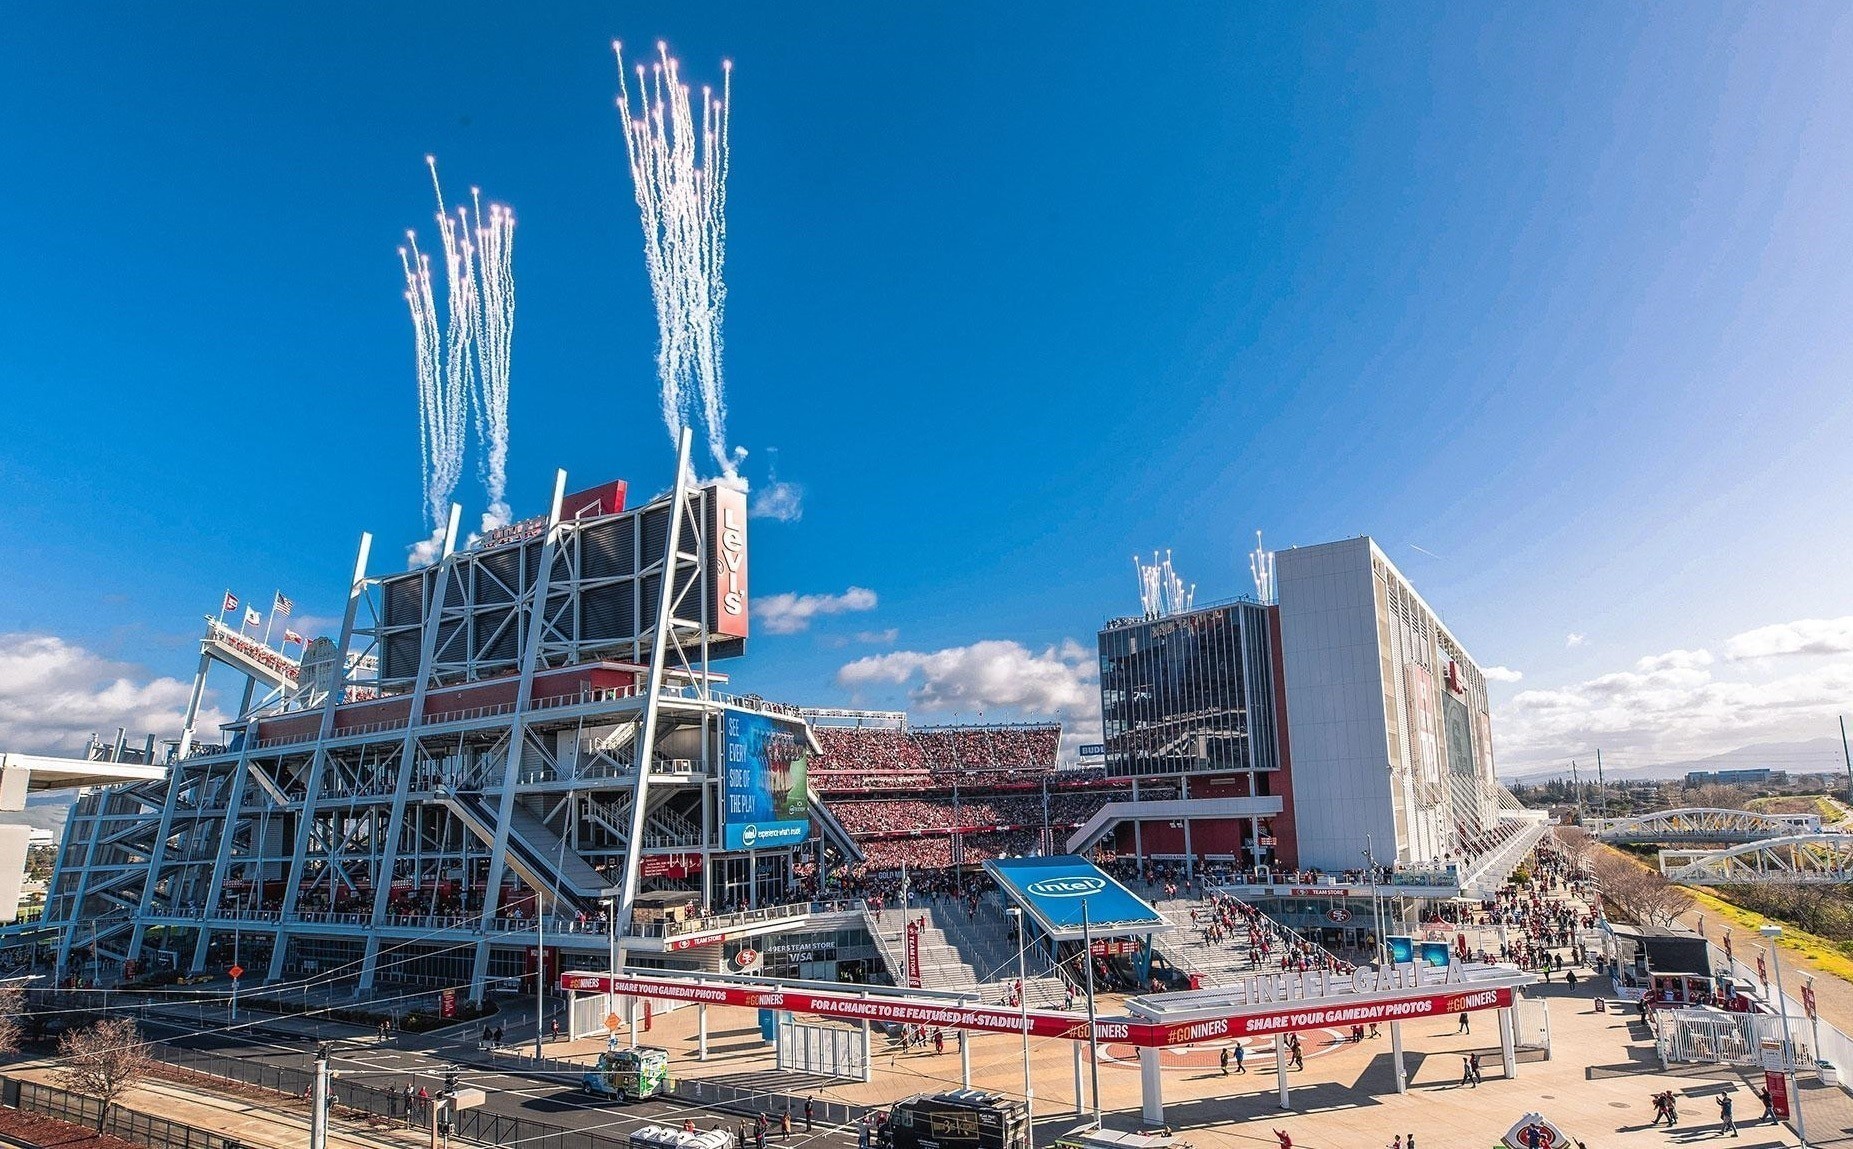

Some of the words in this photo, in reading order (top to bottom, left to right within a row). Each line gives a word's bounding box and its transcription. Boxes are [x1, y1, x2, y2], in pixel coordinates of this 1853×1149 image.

[728, 717, 740, 737] SEE
[729, 743, 747, 762] EVERY
[729, 768, 743, 788] SIDE
[743, 769, 750, 788] OF
[729, 794, 741, 814] THE
[741, 794, 756, 814] PLAY
[757, 829, 779, 840] experience
[693, 936, 708, 945] TEAM
[707, 934, 723, 944] STORE
[768, 944, 791, 953] 49ERS
[791, 942, 812, 951] TEAM
[812, 941, 836, 950] STORE
[788, 952, 813, 962] VISA
[909, 956, 917, 976] STORE
[1244, 969, 1331, 1005] INTEL
[1352, 961, 1431, 993] GATE
[1446, 957, 1468, 984] A
[569, 977, 600, 989] #GONINERS
[615, 981, 638, 993] SHARE
[638, 984, 659, 994] YOUR
[659, 986, 697, 998] GAMEDAY
[695, 988, 726, 1001] PHOTOS
[745, 994, 784, 1006] #GONINERS
[811, 999, 830, 1010] FOR
[829, 1001, 841, 1011] A
[841, 1001, 878, 1015] CHANCE
[878, 1004, 893, 1016] TO
[892, 1006, 906, 1018] BE
[906, 1008, 960, 1023] FEATURED
[1167, 1019, 1228, 1044] #GONINERS
[1246, 1016, 1289, 1032] SHARE
[1290, 1011, 1325, 1027] YOUR
[1325, 1005, 1384, 1023] GAMEDAY
[1385, 1000, 1432, 1016] PHOTOS
[1446, 990, 1497, 1013] #GONINERS
